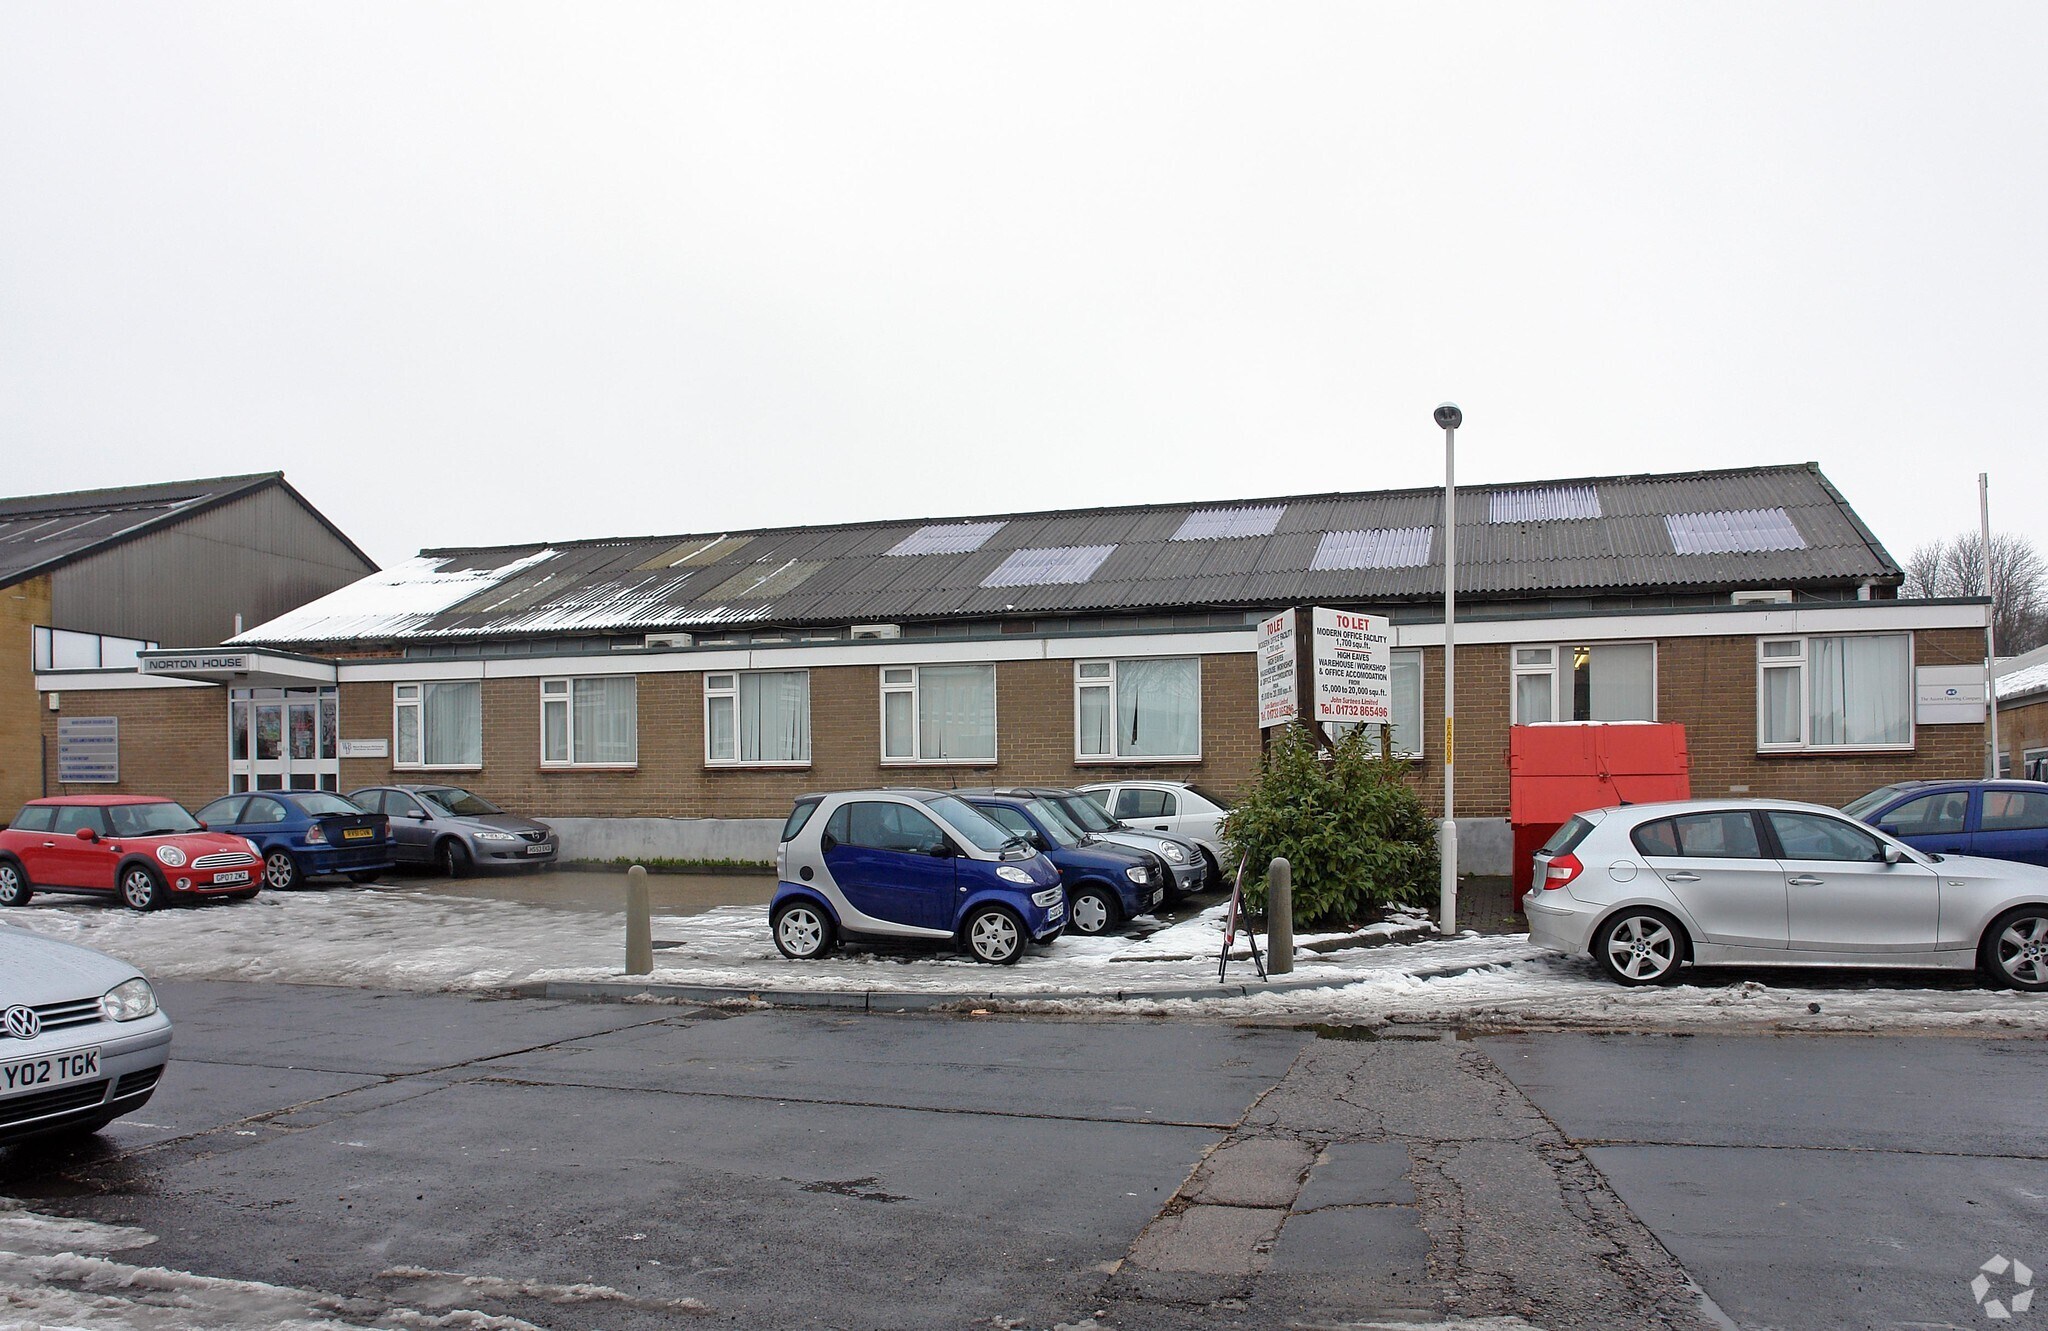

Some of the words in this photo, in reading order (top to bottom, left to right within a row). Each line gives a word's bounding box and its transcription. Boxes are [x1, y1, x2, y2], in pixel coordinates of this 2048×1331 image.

[1267, 622, 1274, 636] TO
[1273, 617, 1284, 633] LET
[1336, 614, 1350, 629] TO
[1351, 617, 1370, 631] LET
[1316, 627, 1342, 638] MODERN
[1342, 630, 1363, 641] OFFICE
[1363, 633, 1388, 644] FACILITY
[1335, 638, 1352, 648] 1,700
[149, 660, 197, 669] NORTON
[202, 658, 242, 668] HOUSE
[1336, 651, 1351, 660] HIGH
[1351, 653, 1370, 662] EAVES
[1318, 658, 1354, 669] WAREHOUSE
[1357, 662, 1387, 672] WORKSHOP
[1318, 667, 1324, 676] &
[1324, 668, 1345, 677] OFFICE
[1345, 670, 1388, 681] ACCOMODATION
[1321, 683, 1342, 694] 15,000
[1341, 686, 1348, 694] to
[1348, 686, 1369, 696] 20,000
[1330, 696, 1342, 704] John
[1320, 703, 1335, 714] Tel.
[1336, 704, 1359, 716] 01732
[1360, 706, 1388, 718] 865496
[216, 873, 233, 881] GP07
[0, 1062, 50, 1090] Y02
[58, 1051, 98, 1078] TGK
